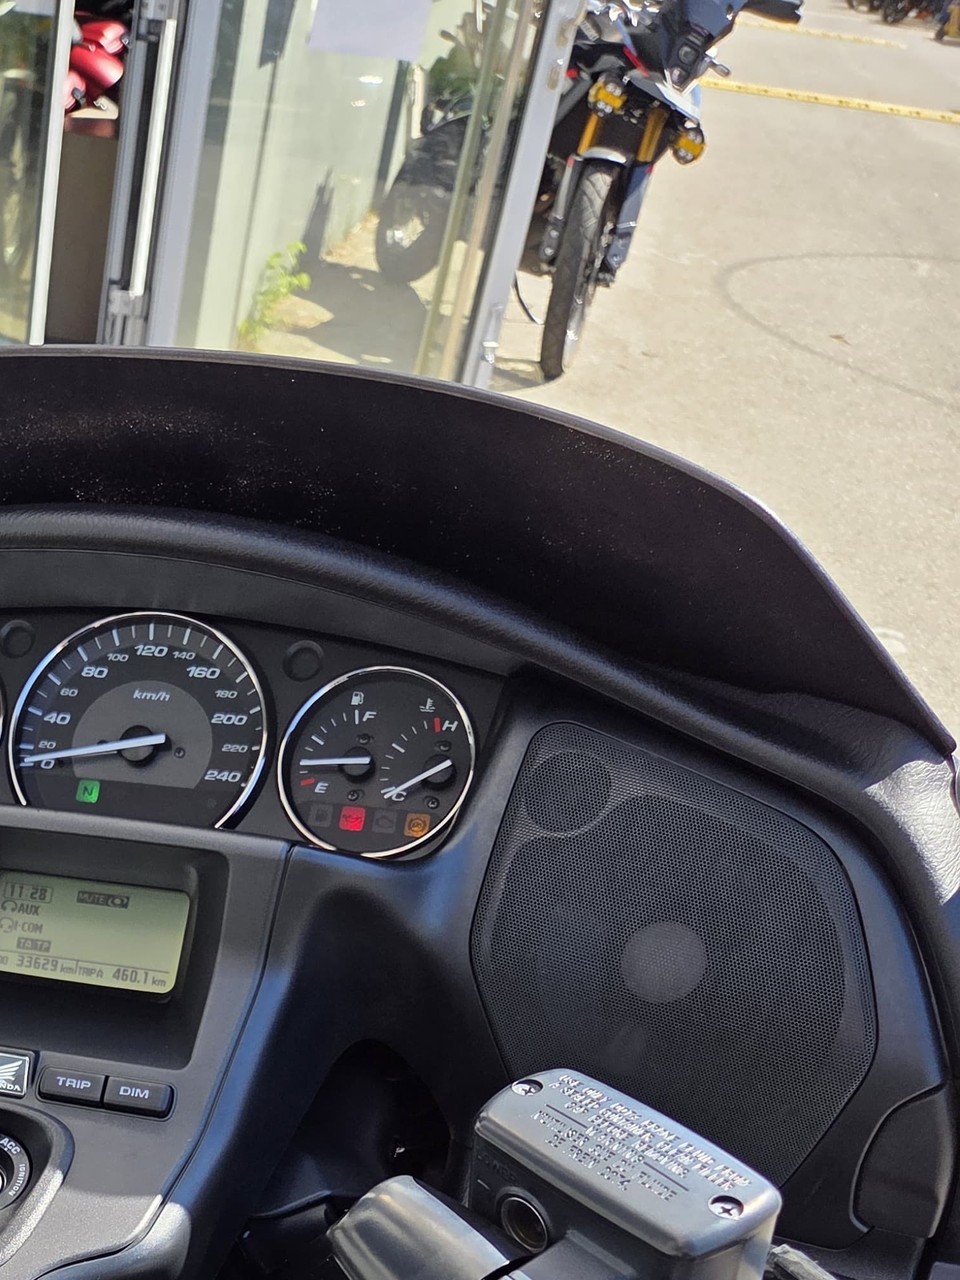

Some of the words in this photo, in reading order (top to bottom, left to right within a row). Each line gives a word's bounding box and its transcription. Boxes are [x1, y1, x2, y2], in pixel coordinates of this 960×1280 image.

[106, 652, 129, 663] 100
[133, 644, 169, 658] 120
[172, 651, 196, 661] 140
[81, 666, 109, 679] 80
[186, 666, 221, 680] 160
[59, 688, 79, 697] 60
[133, 689, 171, 702] km/h
[214, 689, 238, 700] 180
[43, 712, 72, 726] 40
[210, 714, 248, 727] 200
[362, 711, 377, 722] F
[442, 720, 459, 732] H
[38, 740, 57, 750] 20
[221, 743, 248, 754] 220
[40, 759, 55, 770] 0
[204, 770, 241, 783] 240
[314, 782, 329, 794] E
[392, 791, 407, 802] C
[17, 903, 41, 917] AUX
[14, 920, 44, 934] I-COM
[16, 954, 59, 971] 33629
[60, 963, 76, 975] km
[112, 967, 149, 985] 460.1
[151, 977, 167, 988] km
[56, 1076, 92, 1091] TRIP
[119, 1085, 150, 1100] DIM
[0, 1137, 21, 1155] ACC
[8, 1163, 26, 1198] IGNITION
